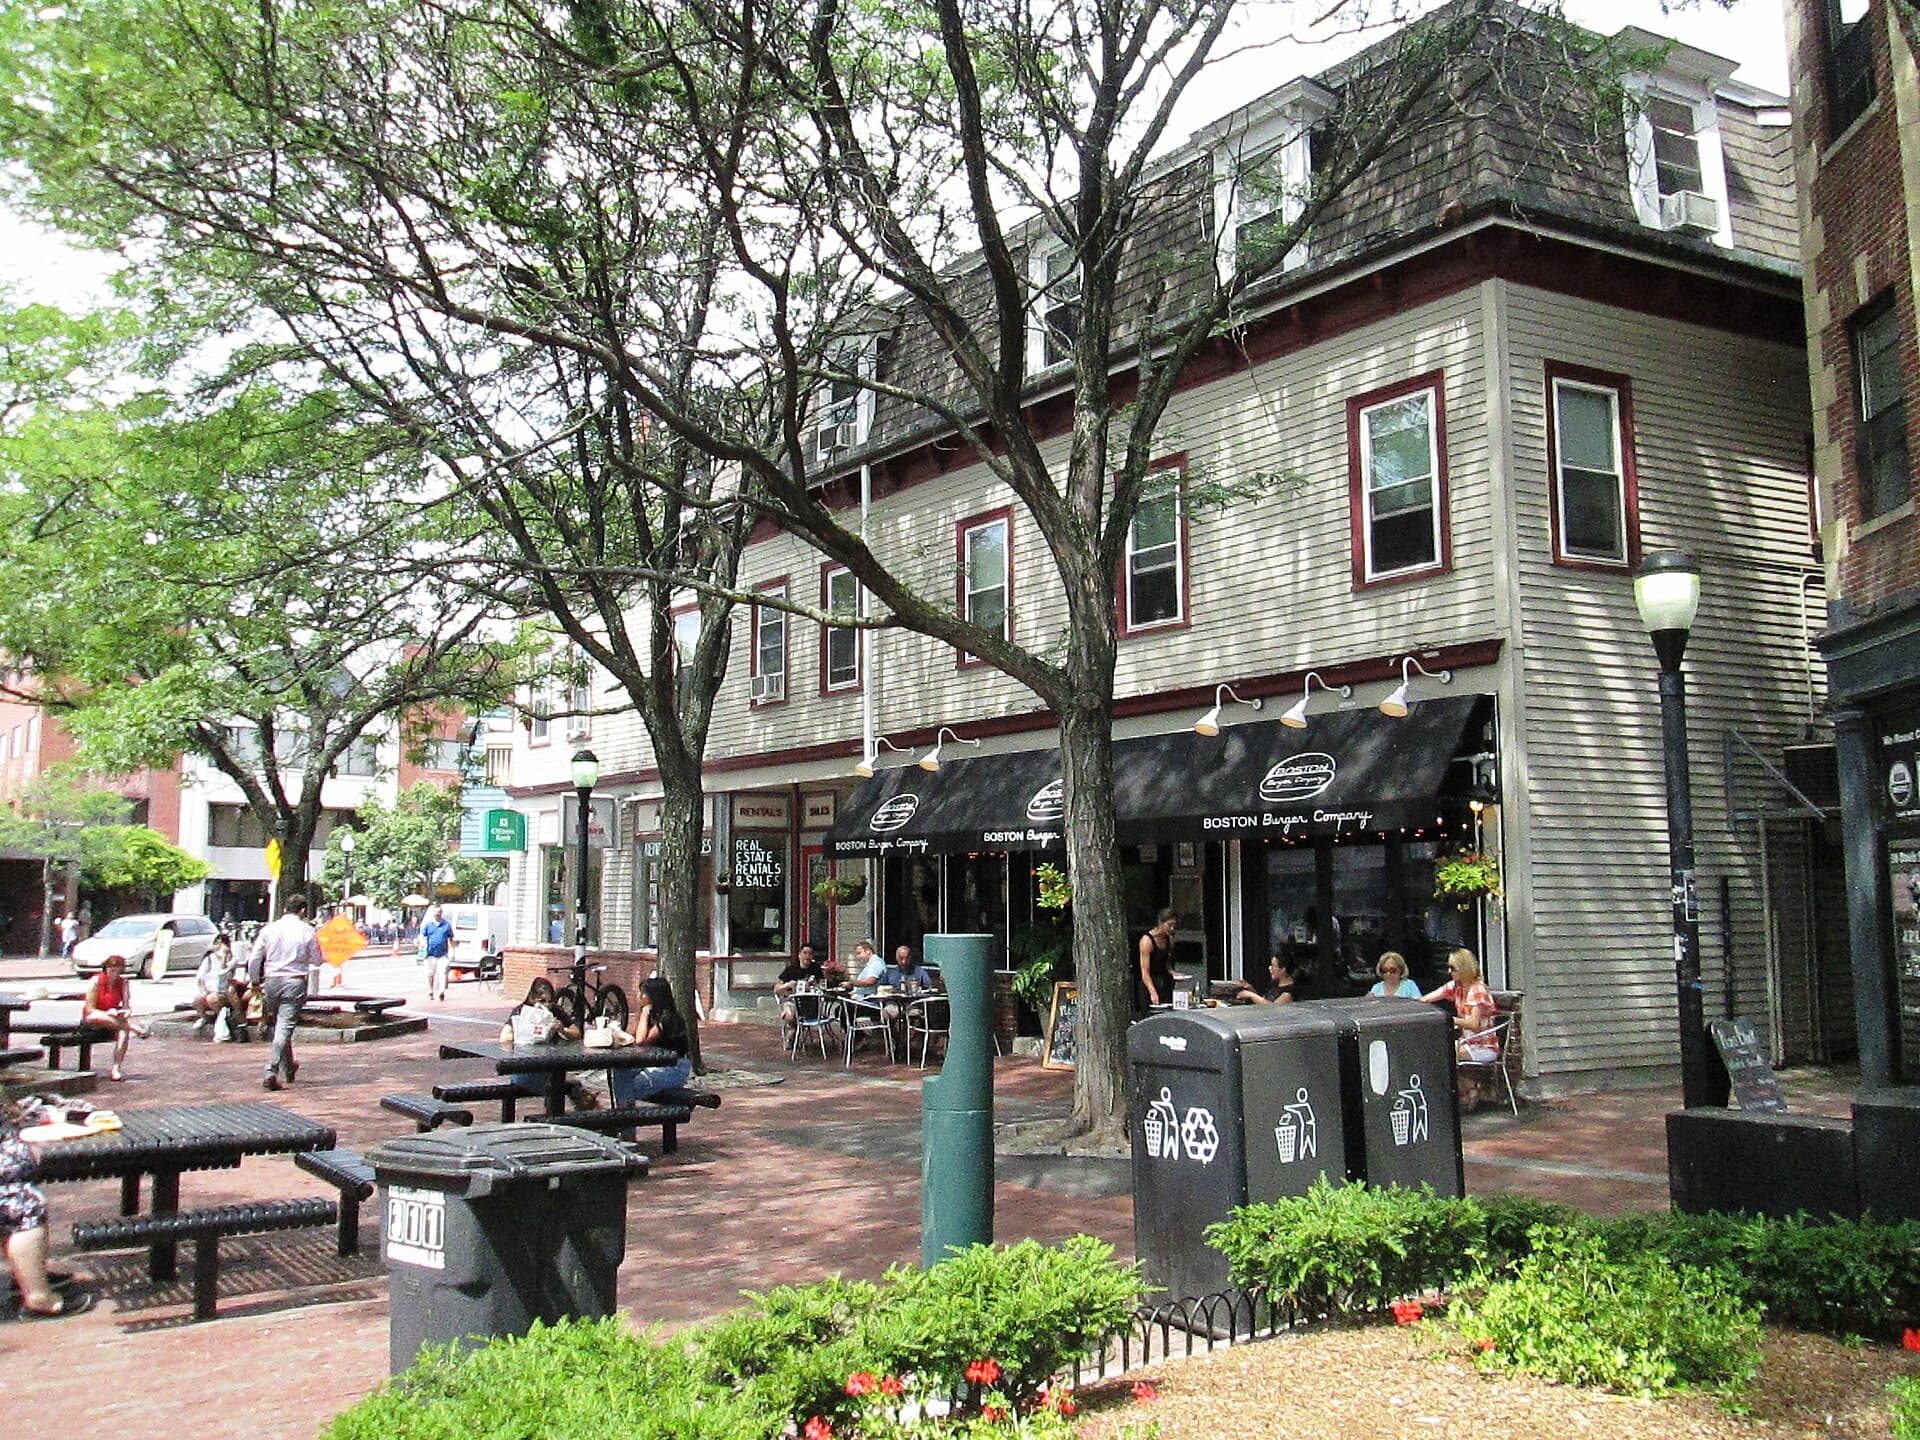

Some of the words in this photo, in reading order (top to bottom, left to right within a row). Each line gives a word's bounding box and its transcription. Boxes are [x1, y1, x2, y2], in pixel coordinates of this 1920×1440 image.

[739, 807, 782, 817] RENTALS
[1203, 815, 1257, 830] BOSTON
[1262, 813, 1308, 833] Burger
[1313, 809, 1373, 831] Company
[735, 839, 763, 851] REAL
[983, 831, 1024, 842] BOSTON
[1026, 829, 1060, 849] Burger
[835, 840, 866, 851] BOSTON
[735, 851, 773, 863] ESTATE
[735, 863, 781, 875] RENTALS
